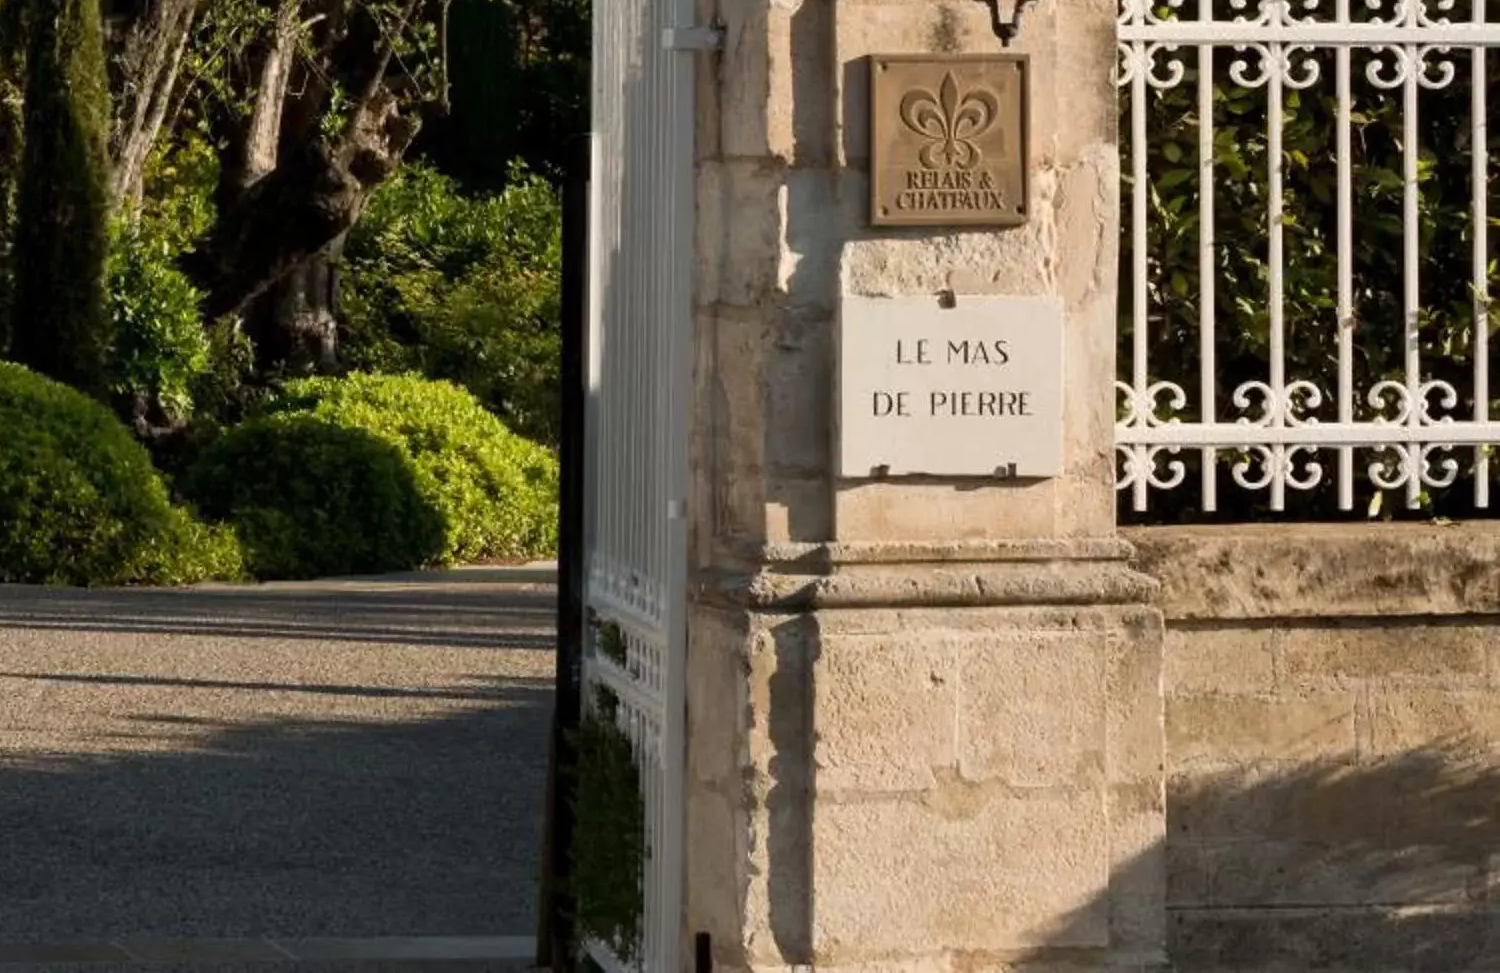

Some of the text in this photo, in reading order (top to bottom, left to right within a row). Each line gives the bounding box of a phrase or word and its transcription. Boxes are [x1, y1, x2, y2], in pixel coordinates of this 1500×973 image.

[906, 170, 994, 189] RELAIS &
[897, 339, 1009, 365] LE MAS
[873, 392, 1033, 417] DE PIERRE
